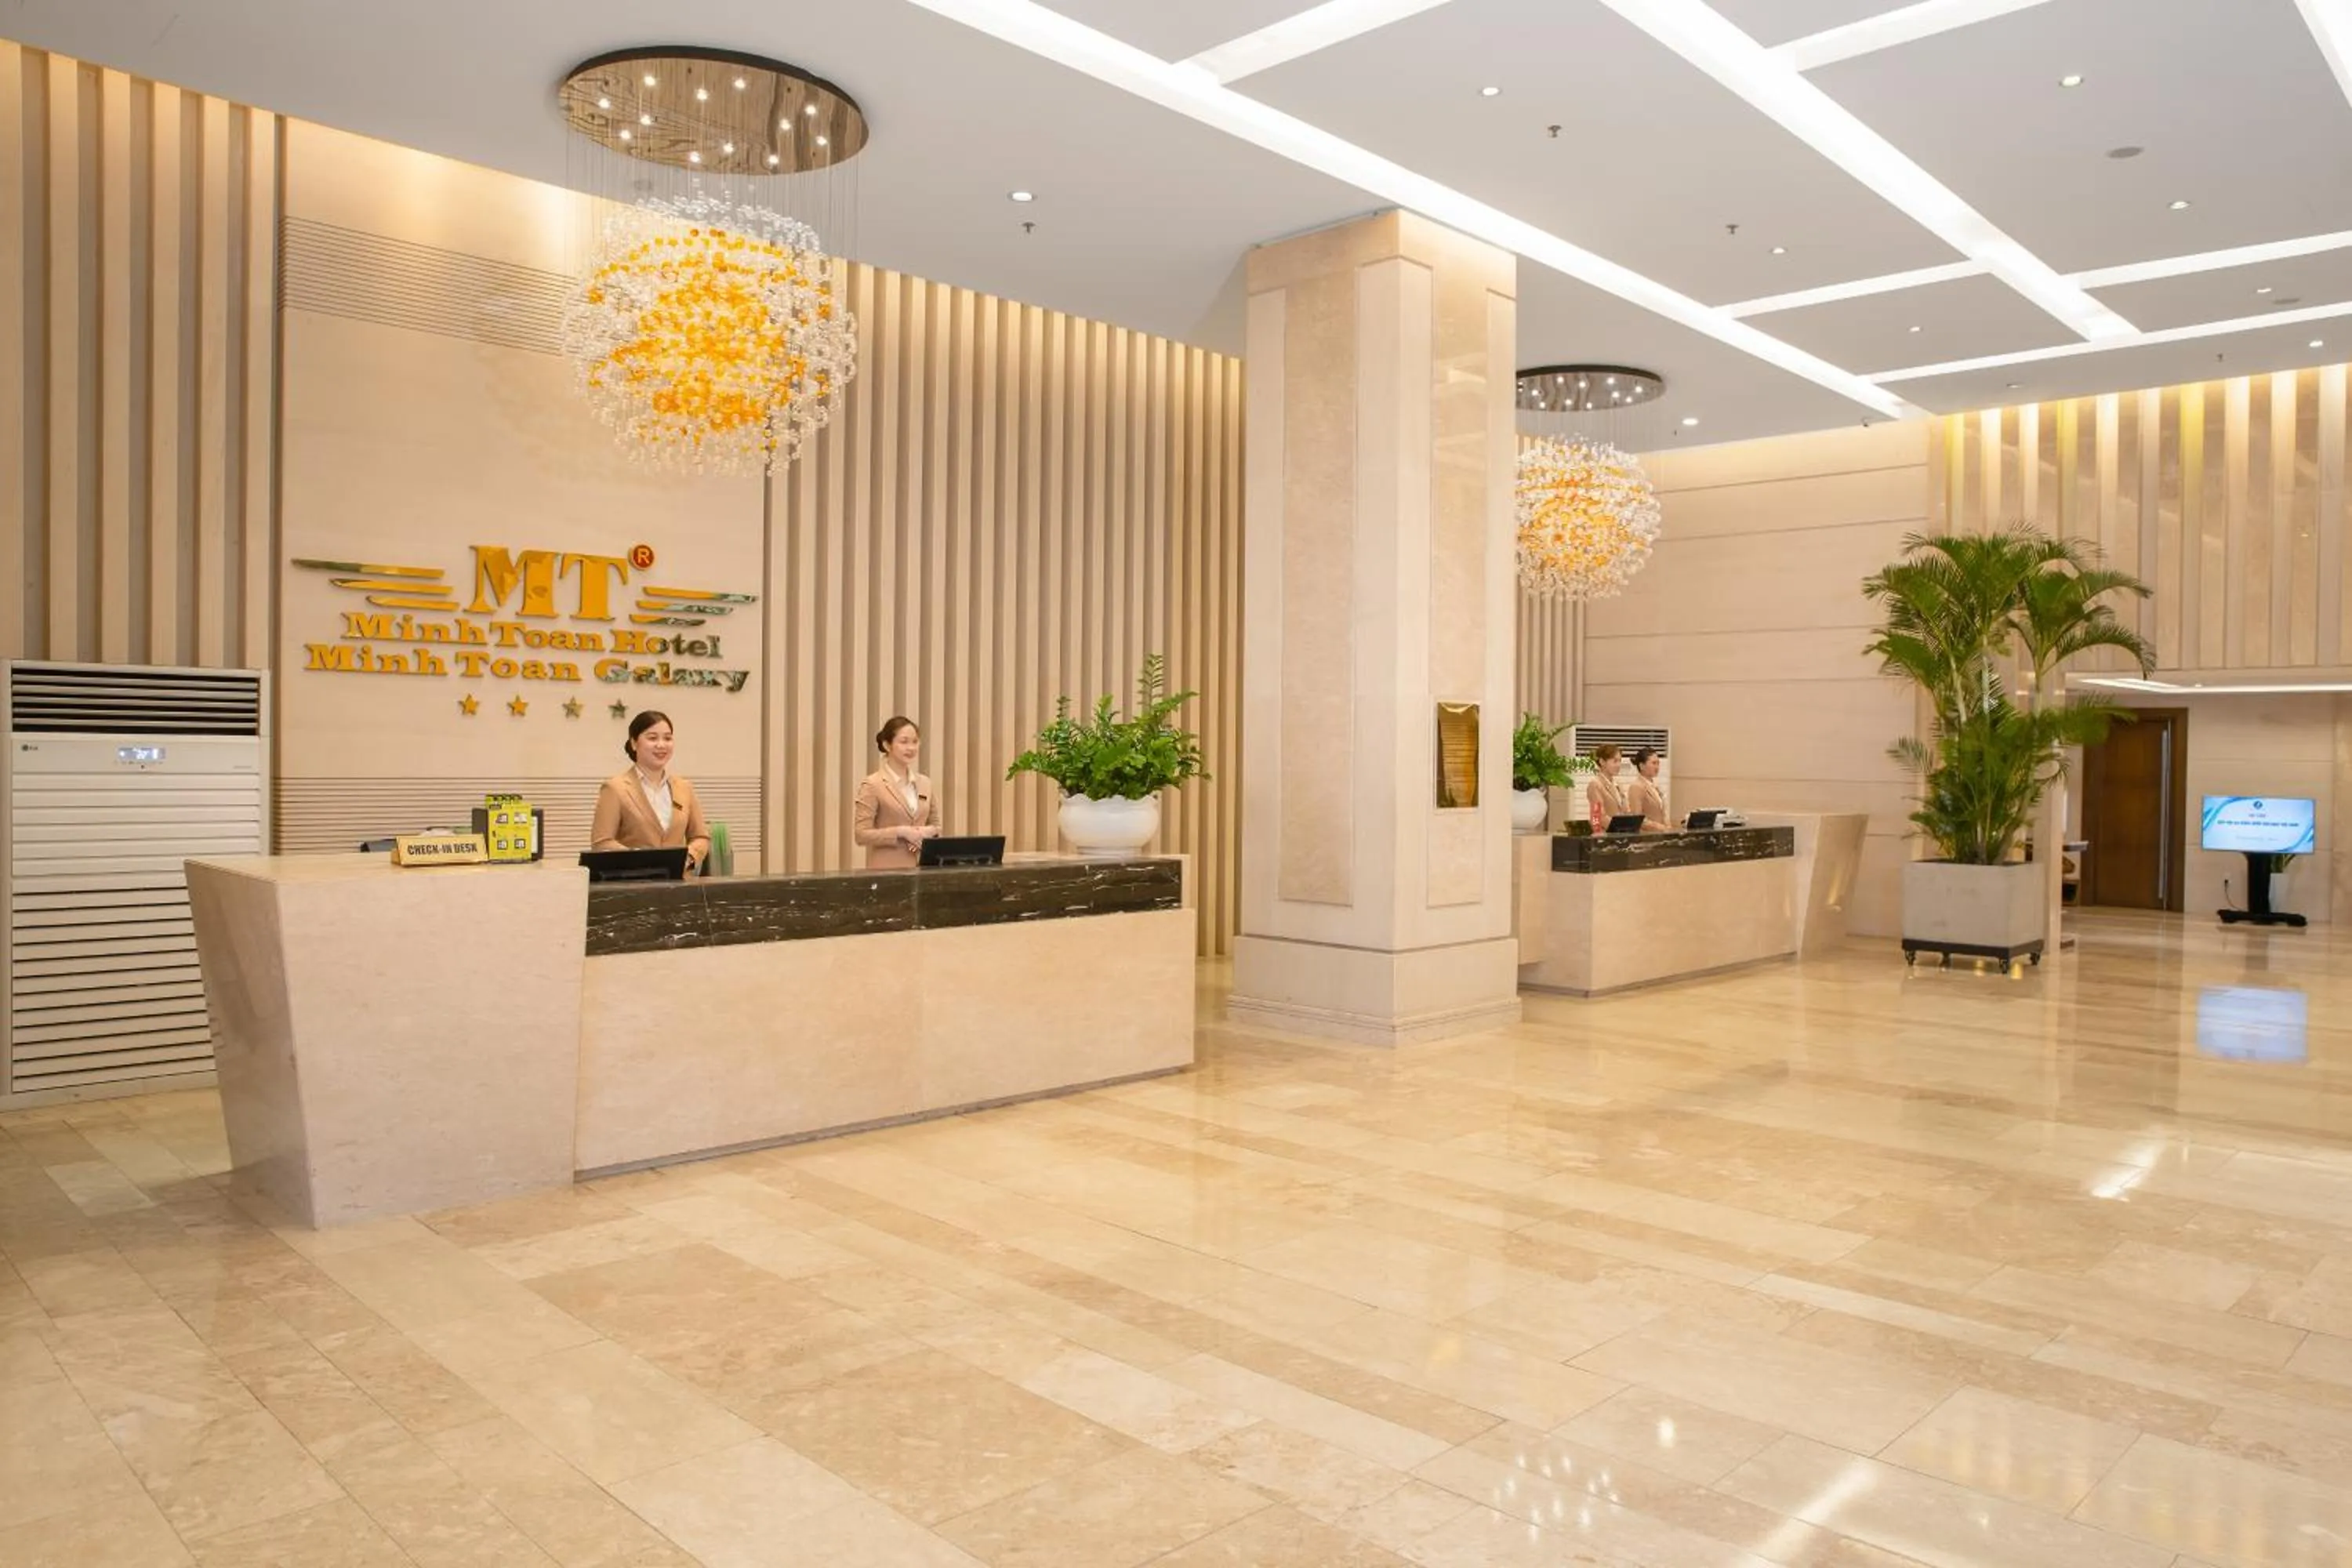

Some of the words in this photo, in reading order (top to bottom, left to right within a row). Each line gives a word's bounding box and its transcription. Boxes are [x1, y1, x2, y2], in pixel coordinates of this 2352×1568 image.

[463, 545, 628, 622] MT
[340, 612, 487, 644] Minh
[489, 621, 605, 652] Toan
[610, 629, 723, 659] Hotel
[303, 643, 448, 676] Minh
[455, 651, 582, 681] Toan
[593, 658, 750, 692] Galaxy
[407, 843, 452, 855] CHECK-IN
[454, 843, 477, 854] DESK
